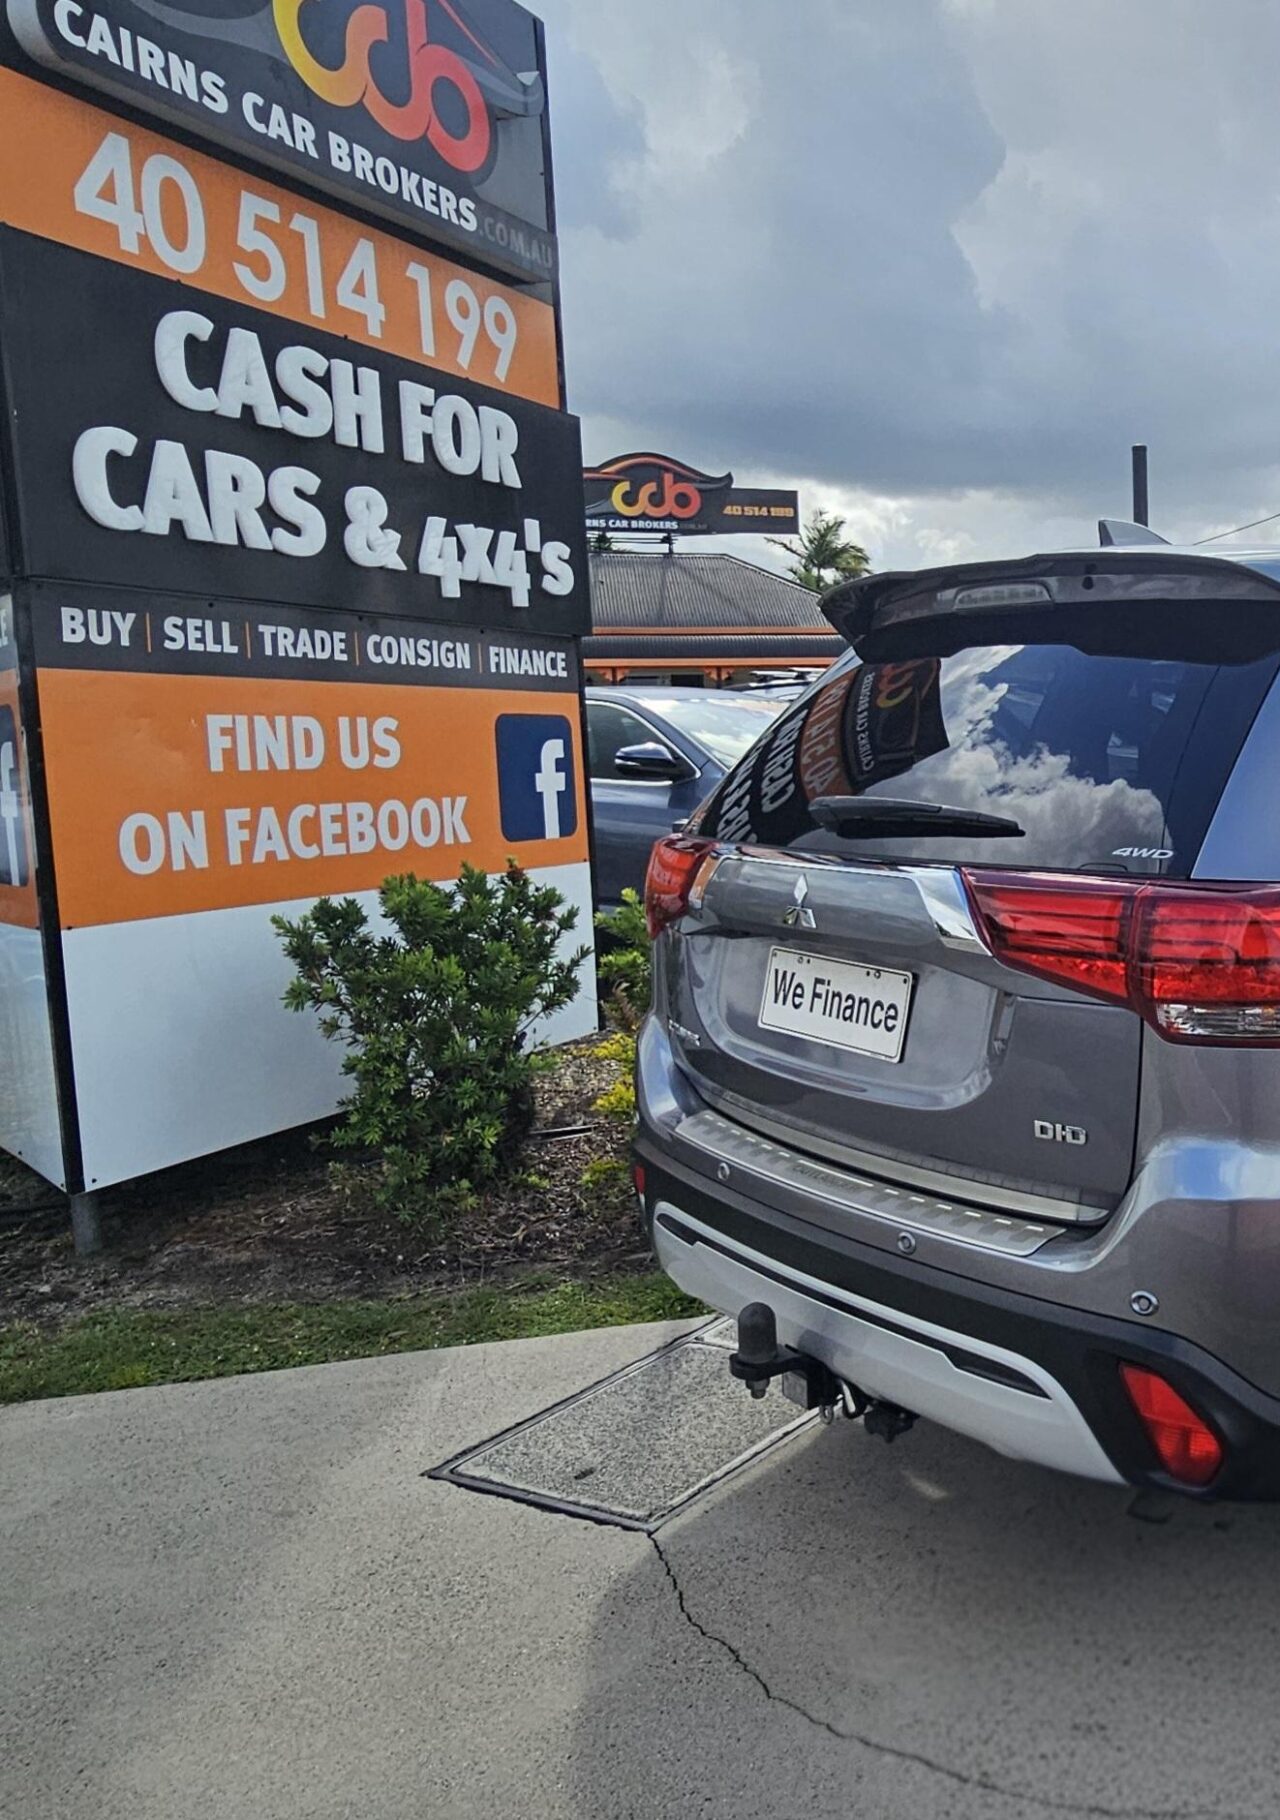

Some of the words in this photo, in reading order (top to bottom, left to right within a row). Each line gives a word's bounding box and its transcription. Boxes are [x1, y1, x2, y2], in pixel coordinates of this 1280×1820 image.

[53, 0, 229, 114] CAIRNS
[242, 91, 319, 160] CAR
[328, 130, 478, 232] BROKERS
[73, 131, 206, 275] 40
[232, 189, 387, 339] 514
[405, 261, 518, 384] 199
[154, 310, 385, 453] CASH
[398, 379, 522, 489] FOR
[72, 425, 327, 558] CARS
[344, 485, 407, 571] &
[608, 519, 629, 529] CAR
[631, 520, 678, 530] BROKERS
[60, 606, 136, 648] BUY
[163, 616, 239, 655] SELL
[258, 624, 349, 662] TRADE
[366, 634, 471, 670] CONSIGN
[489, 646, 568, 679] FINANCE
[206, 714, 325, 773] FIND
[338, 715, 402, 770] US
[118, 809, 209, 876] ON
[225, 796, 472, 866] FACEBOOK
[1111, 847, 1174, 859] 4WD
[773, 968, 805, 1010] We
[809, 977, 899, 1033] Finance
